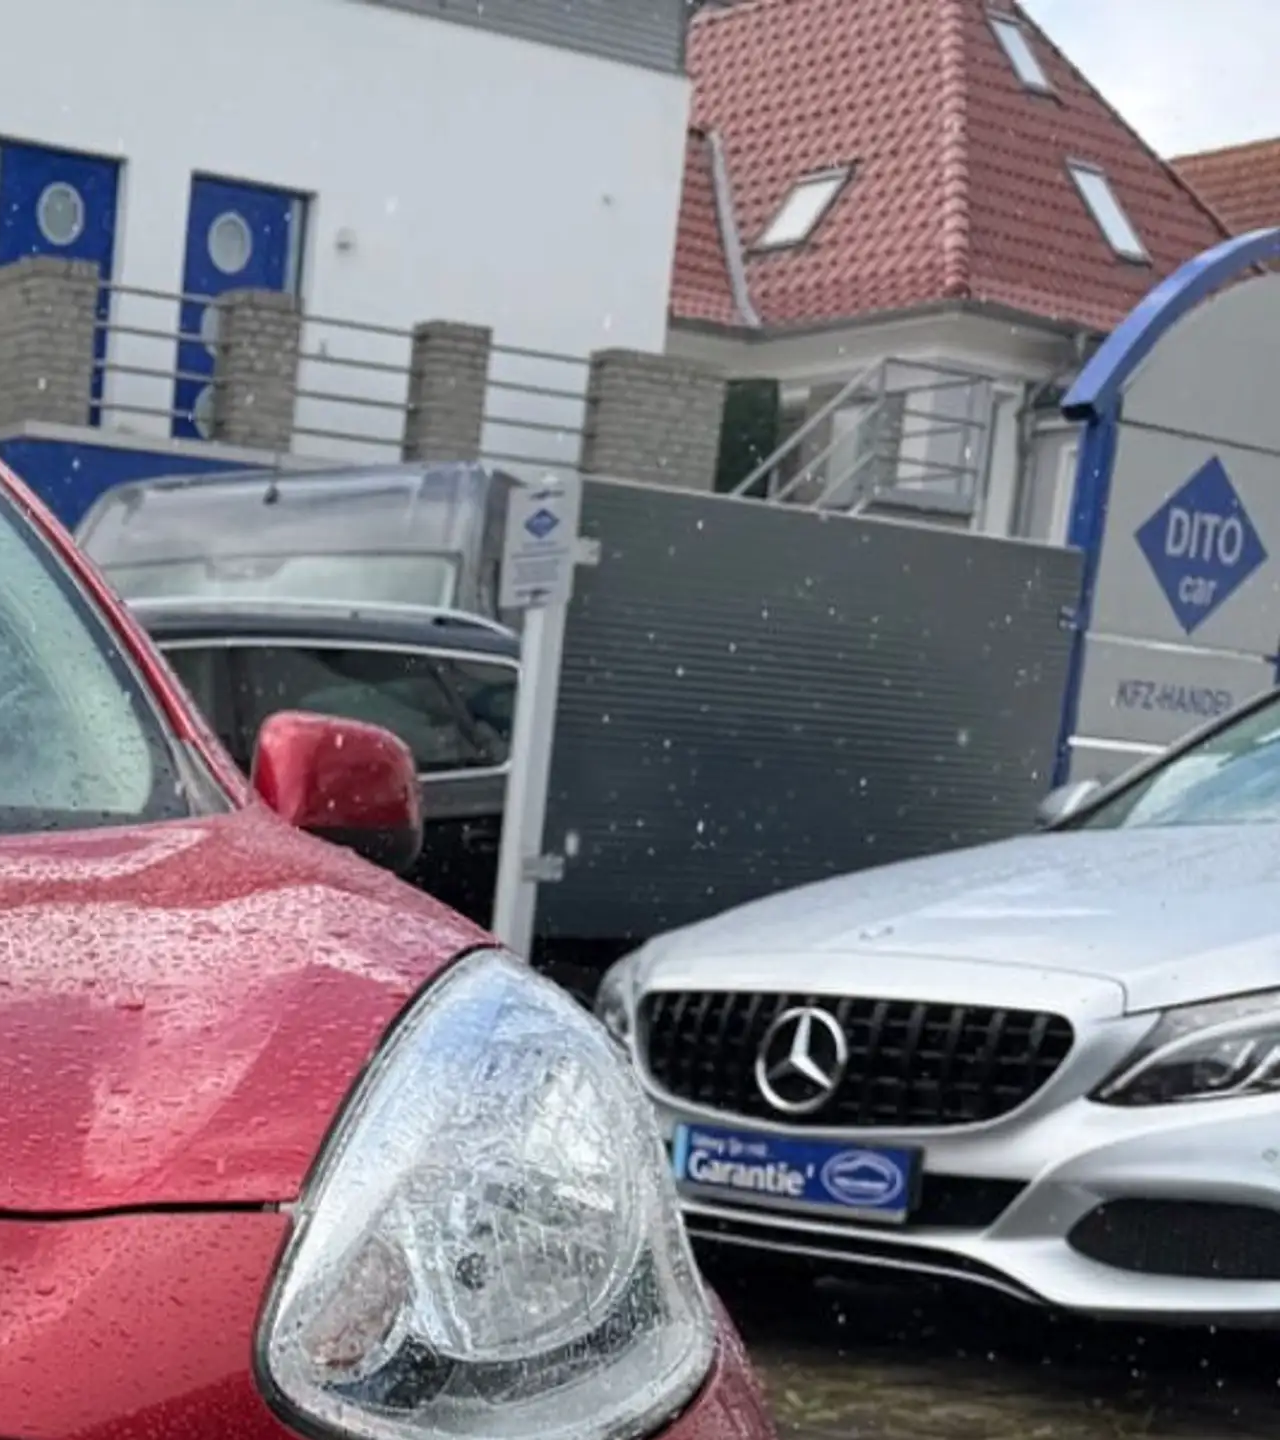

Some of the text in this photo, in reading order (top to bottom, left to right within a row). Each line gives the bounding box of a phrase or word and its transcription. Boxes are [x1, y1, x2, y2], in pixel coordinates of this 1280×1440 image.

[1165, 507, 1243, 567] DITO
[1178, 575, 1218, 605] car
[688, 1149, 806, 1197] Garantie
